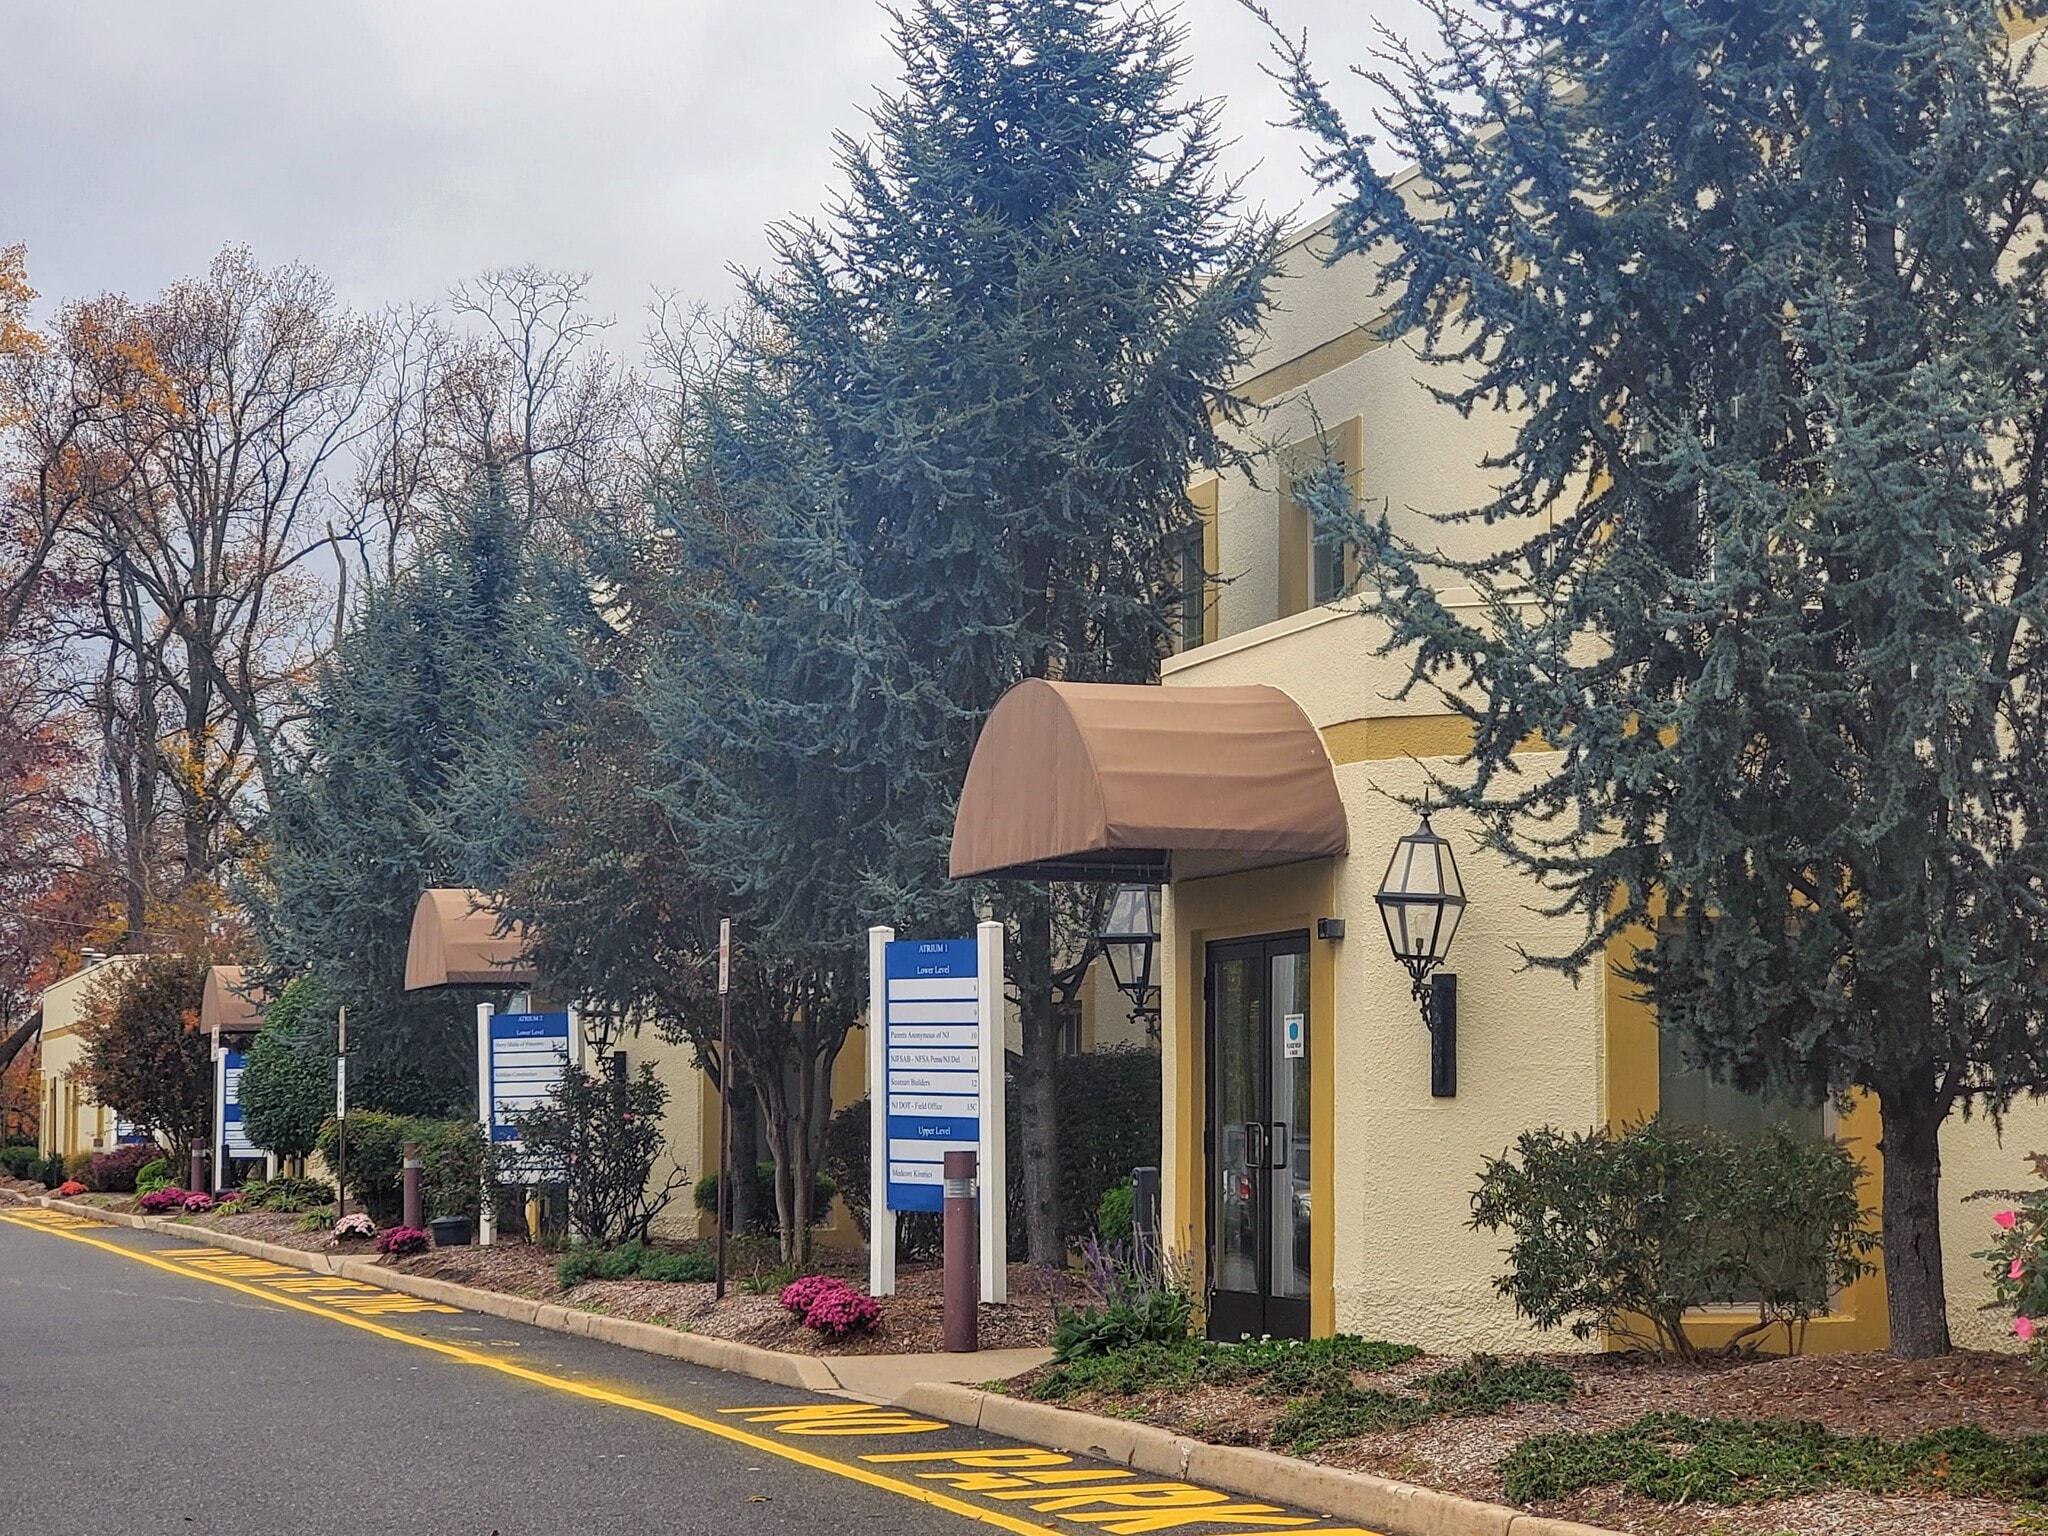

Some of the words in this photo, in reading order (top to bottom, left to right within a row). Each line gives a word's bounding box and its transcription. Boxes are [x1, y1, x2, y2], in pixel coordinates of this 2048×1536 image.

[918, 943, 944, 953] ATRIUM
[917, 966, 934, 974] Lower
[935, 965, 950, 974] Level
[890, 1031, 907, 1039] Parents
[908, 1031, 935, 1040] Anonymous
[942, 1031, 949, 1039] NJ
[971, 1032, 977, 1040] 10
[910, 1078, 931, 1087] Builders
[971, 1079, 977, 1088] 12
[899, 1102, 911, 1110] DOT
[914, 1102, 927, 1110] Field
[927, 1102, 943, 1111] Office
[967, 1103, 977, 1111] 15C
[918, 1126, 934, 1137] Upper
[935, 1126, 951, 1135] Level
[715, 1403, 950, 1436] NO
